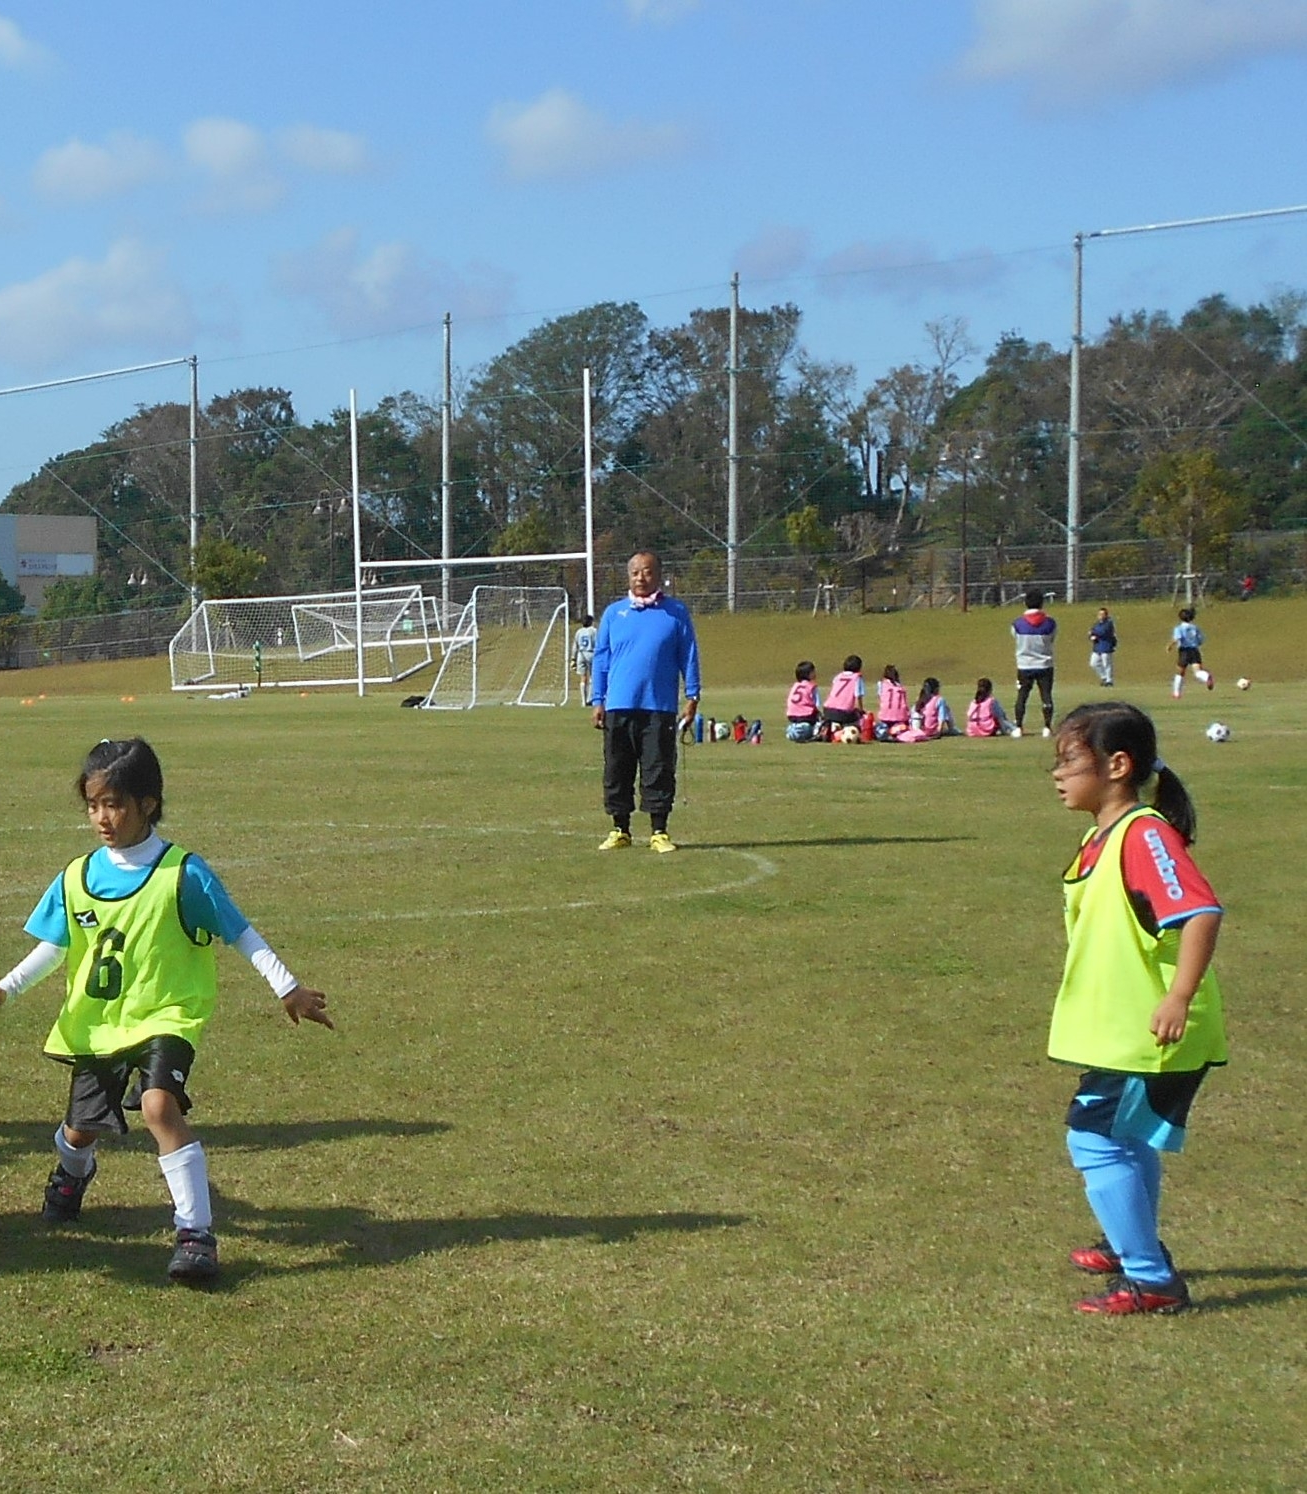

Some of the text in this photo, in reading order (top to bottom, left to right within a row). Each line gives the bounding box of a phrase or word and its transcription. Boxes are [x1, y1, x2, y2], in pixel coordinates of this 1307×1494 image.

[580, 635, 589, 648] 5
[791, 685, 806, 704] 5
[835, 678, 852, 698] 7
[1144, 828, 1183, 900] umbro
[85, 927, 126, 1000] 6
